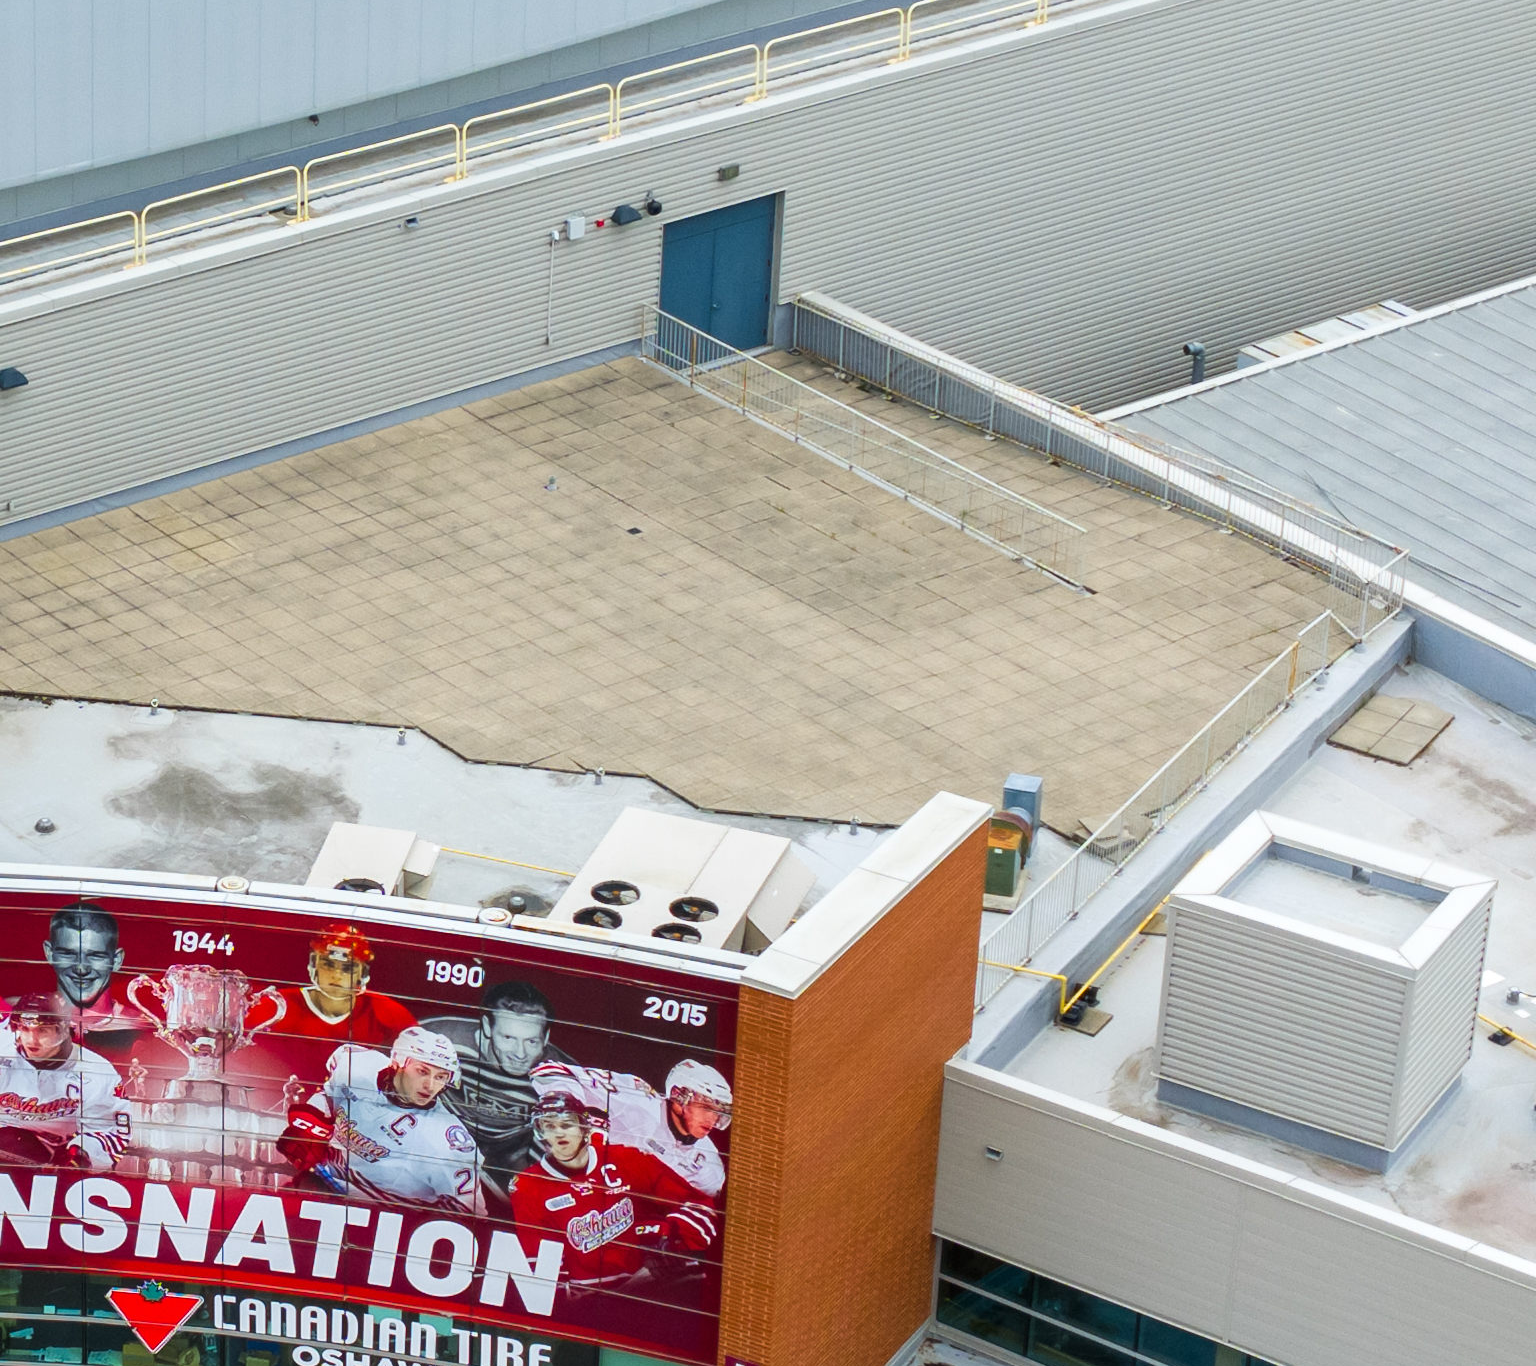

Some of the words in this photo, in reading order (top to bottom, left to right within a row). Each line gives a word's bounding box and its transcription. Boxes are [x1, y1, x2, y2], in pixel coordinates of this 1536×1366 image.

[172, 930, 235, 956] 1944
[425, 959, 485, 988] 1990
[642, 996, 709, 1027] 2015
[213, 1293, 437, 1360] CANADIAN
